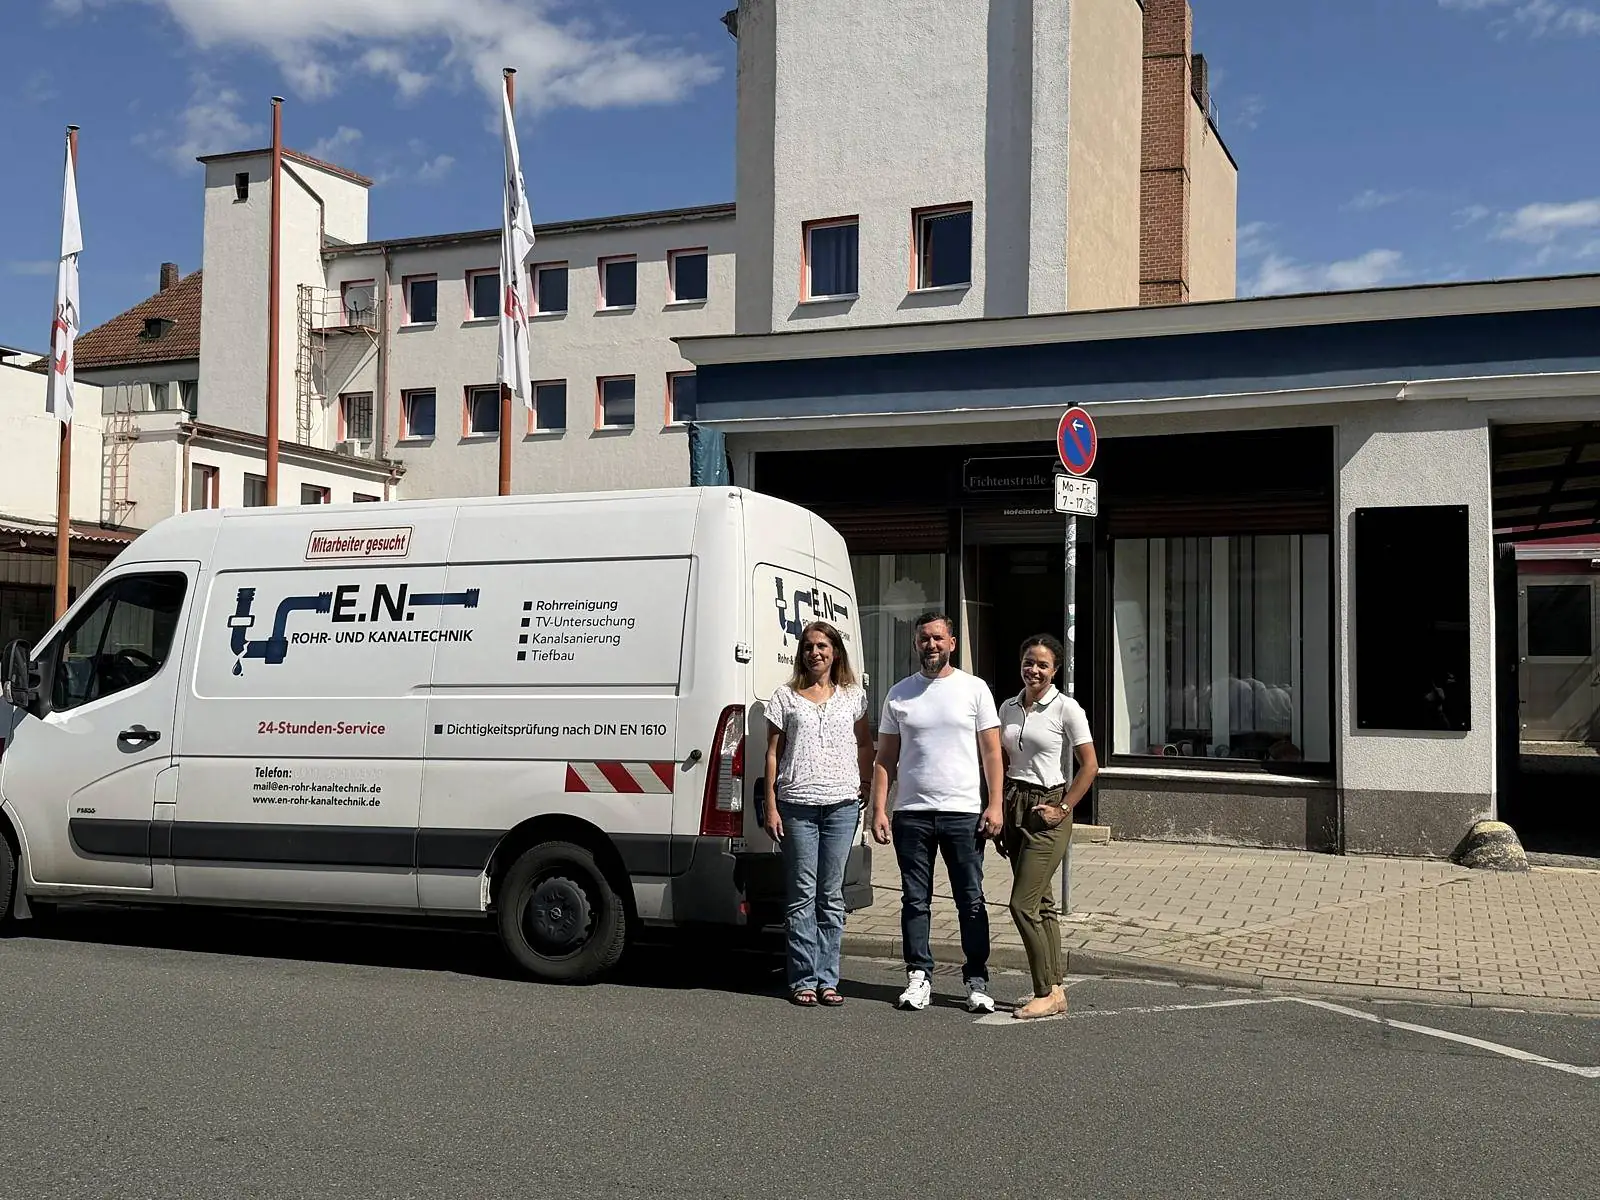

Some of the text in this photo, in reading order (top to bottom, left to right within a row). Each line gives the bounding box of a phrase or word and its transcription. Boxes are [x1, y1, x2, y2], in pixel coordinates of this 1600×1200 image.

[968, 473, 1047, 488] Fichtenstraße
[1062, 480, 1074, 492] Mo
[1082, 483, 1091, 494] Fr
[1063, 495, 1068, 506] 7
[1076, 498, 1084, 508] 17
[311, 534, 406, 555] Mitarbeiter gesucht
[332, 583, 415, 622] E.N.
[536, 600, 618, 611] Rohrreinigung
[811, 588, 837, 622] E.N.
[536, 615, 636, 629] TV-Untersuchung
[291, 630, 474, 644] ROHR- UND KANALTECHNIK
[532, 632, 621, 646] Kanalsanierung
[532, 649, 575, 661] Tiefbau
[258, 721, 386, 734] 24-Stunden-Service
[447, 724, 667, 737] Dichtigkeitsprüfung nach DIN EN 1610
[255, 766, 292, 778] Telefon:
[253, 781, 382, 793] mail@en-rohr-kanaltechnik.de
[252, 796, 381, 807] www.en-rohr-kanaltechnik.de
